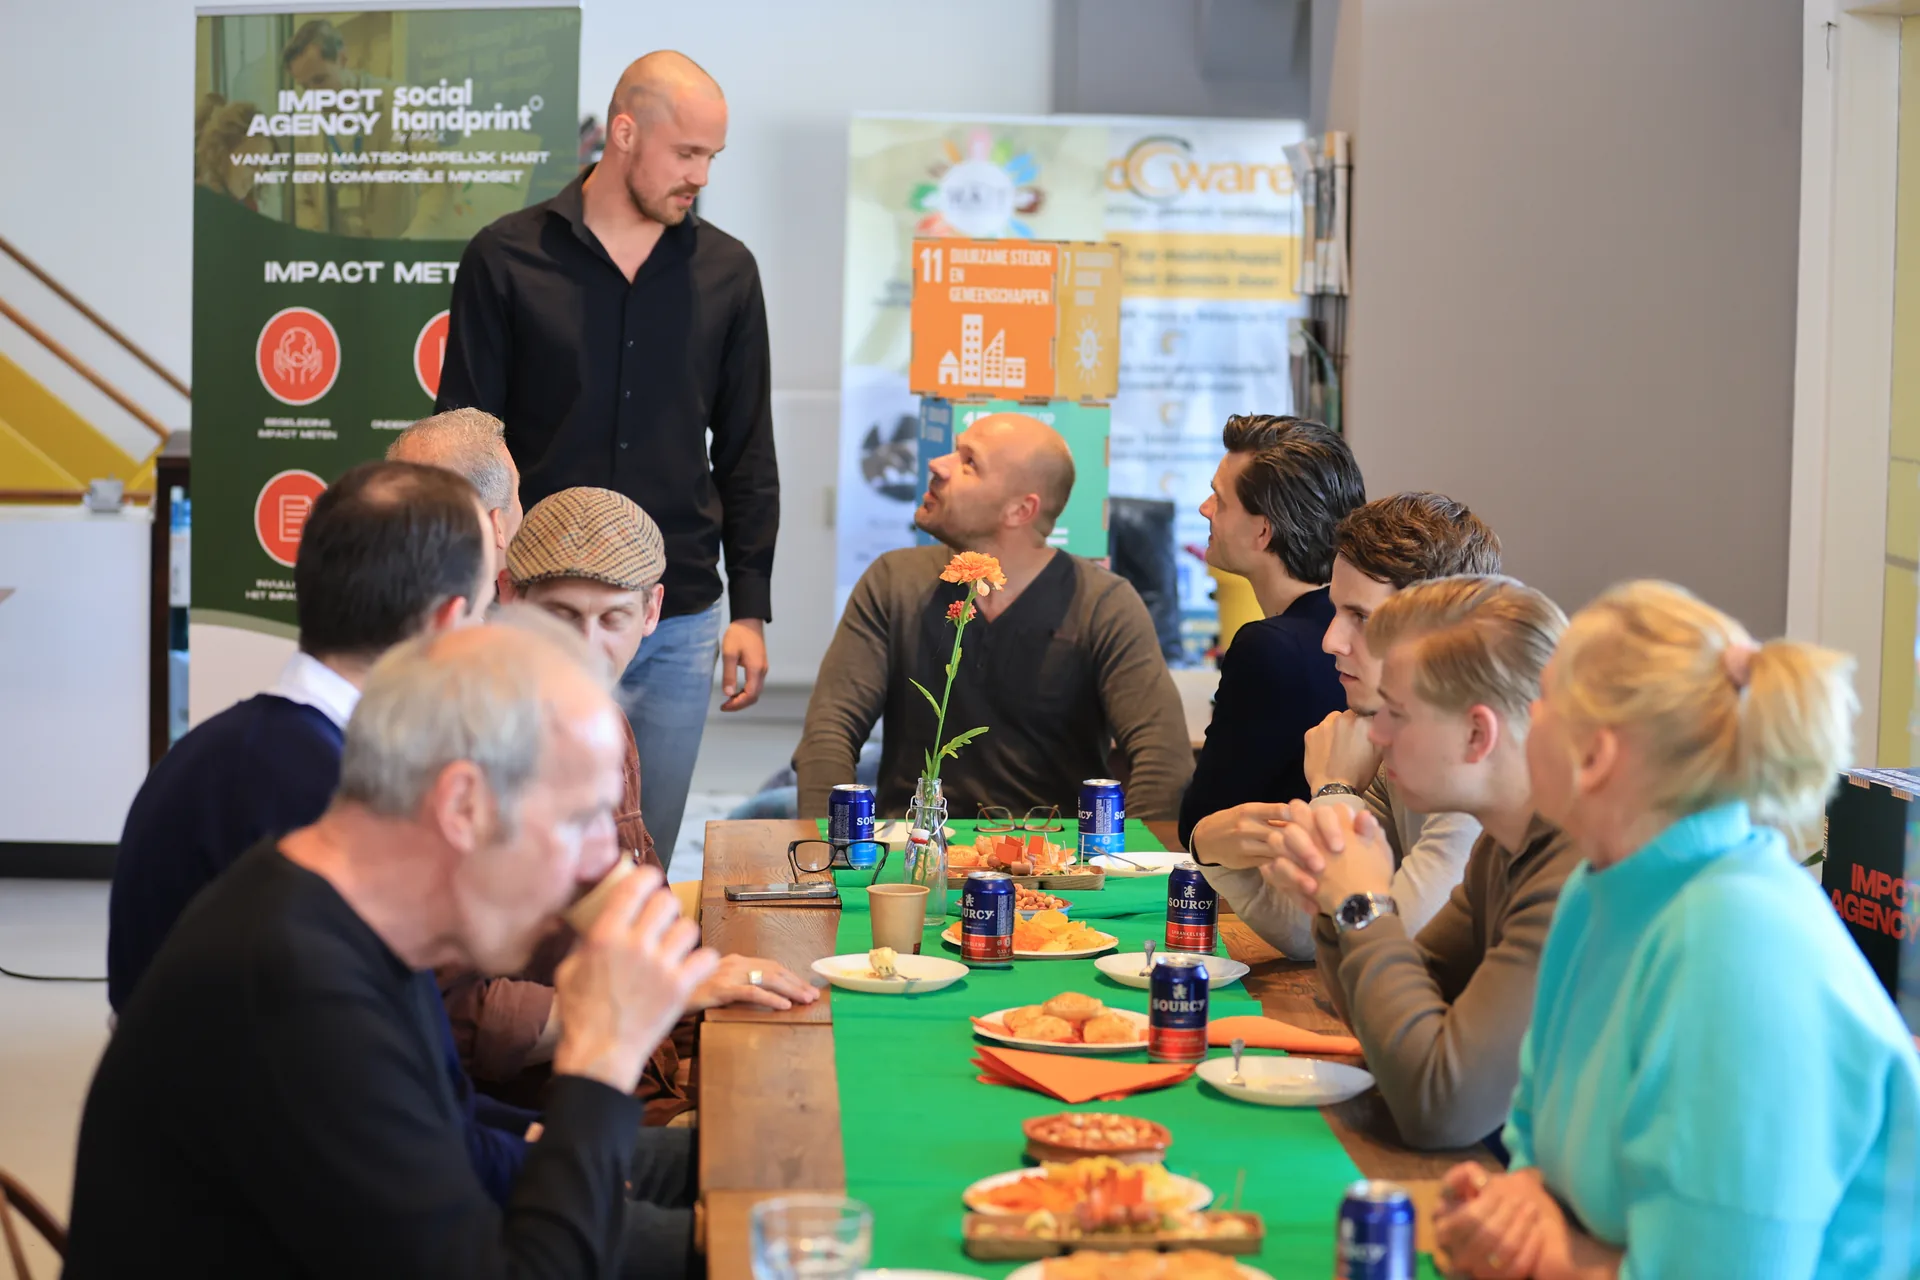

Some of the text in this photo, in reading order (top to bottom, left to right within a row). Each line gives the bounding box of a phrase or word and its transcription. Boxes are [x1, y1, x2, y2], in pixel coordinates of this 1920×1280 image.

[278, 88, 383, 113] IMPCT
[393, 78, 473, 107] social
[246, 112, 382, 137] AGENCY
[391, 102, 532, 138] handprint
[230, 152, 291, 166] VANUIT
[294, 152, 329, 165] EEN
[500, 150, 551, 164] HART
[254, 170, 288, 184] MET
[292, 170, 327, 184] EEN
[447, 169, 525, 183] MINDSET
[264, 260, 460, 284] IMPACT MET
[920, 248, 943, 283] 11
[1009, 249, 1052, 267] STEDEN
[949, 267, 965, 283] EN
[1851, 863, 1920, 908] IMPCT
[1168, 897, 1213, 910] SOURCY
[1831, 888, 1920, 944] AGENCY
[1152, 998, 1206, 1013] SOURCY
